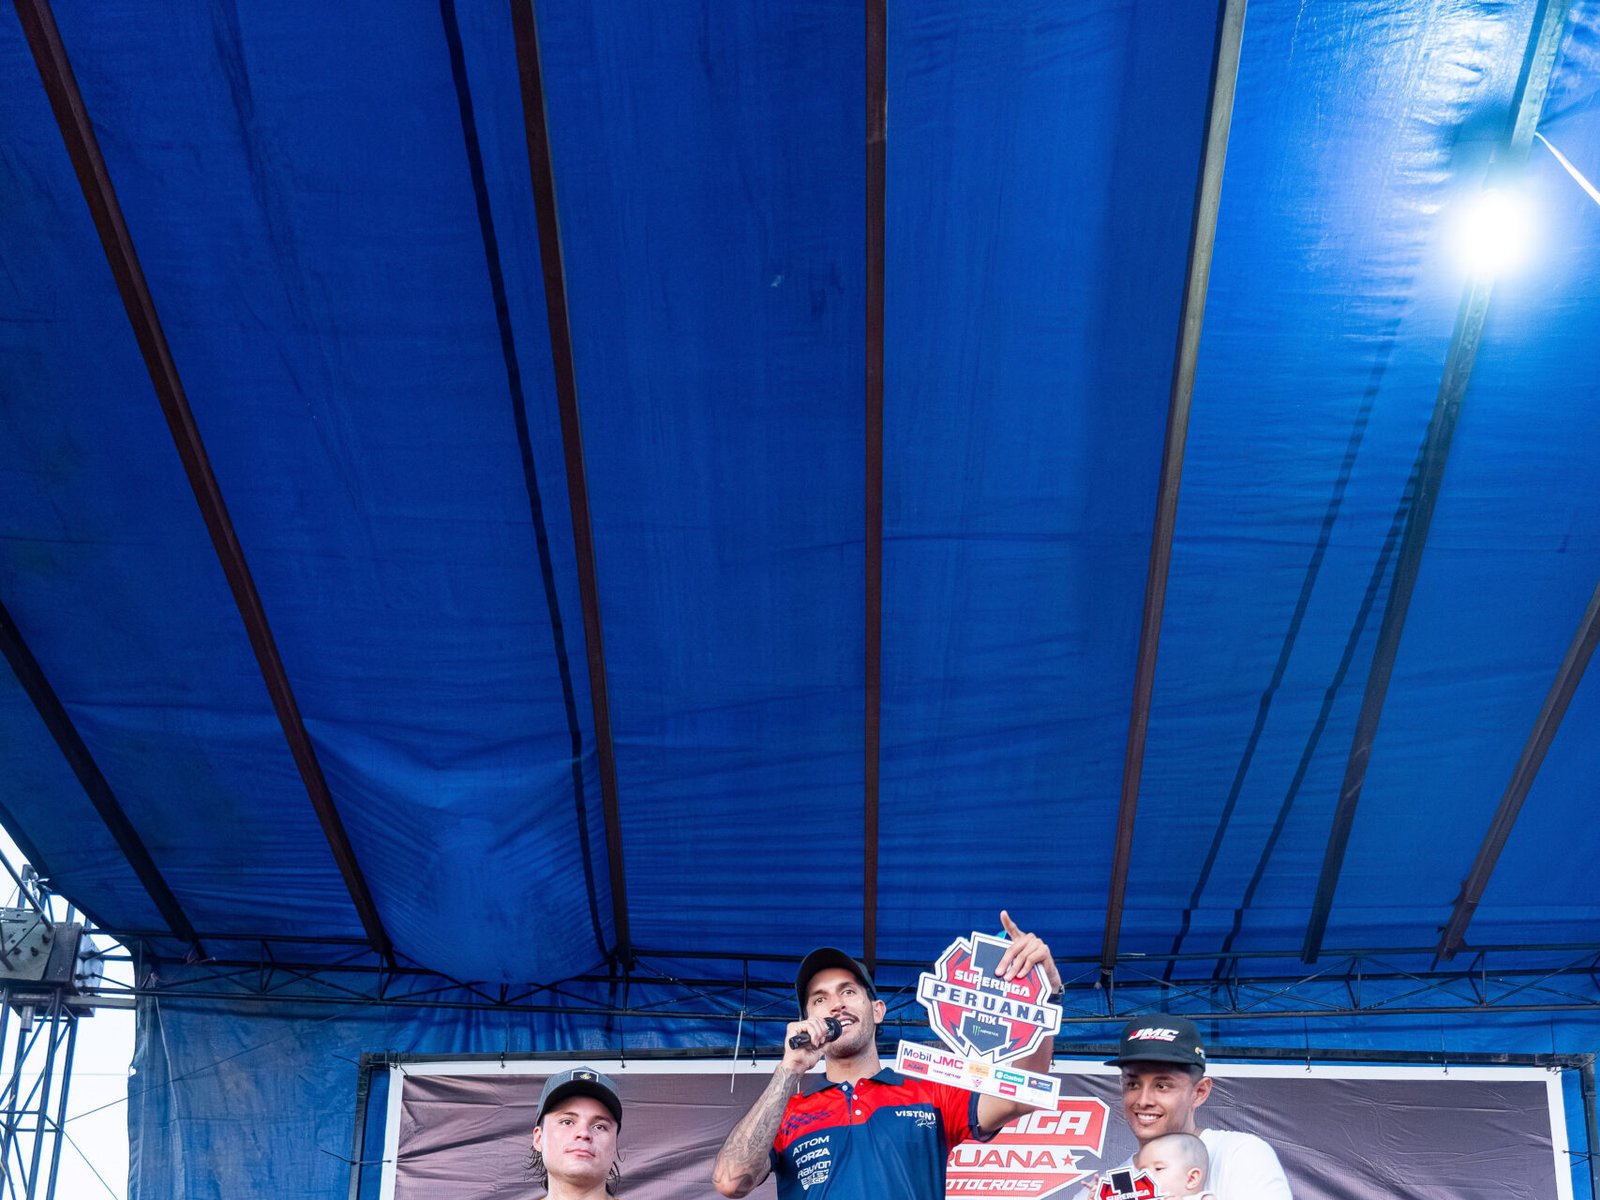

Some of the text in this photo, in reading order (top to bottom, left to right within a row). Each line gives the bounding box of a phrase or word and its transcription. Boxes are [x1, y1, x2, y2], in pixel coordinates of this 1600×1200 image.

[932, 983, 1046, 1024] PERUANA
[903, 1047, 932, 1062] Mobil
[933, 1055, 964, 1070] JMC
[792, 1135, 830, 1157] ATTOM
[795, 1147, 831, 1168] FORZA
[946, 1178, 1044, 1192] OTOCROSS
